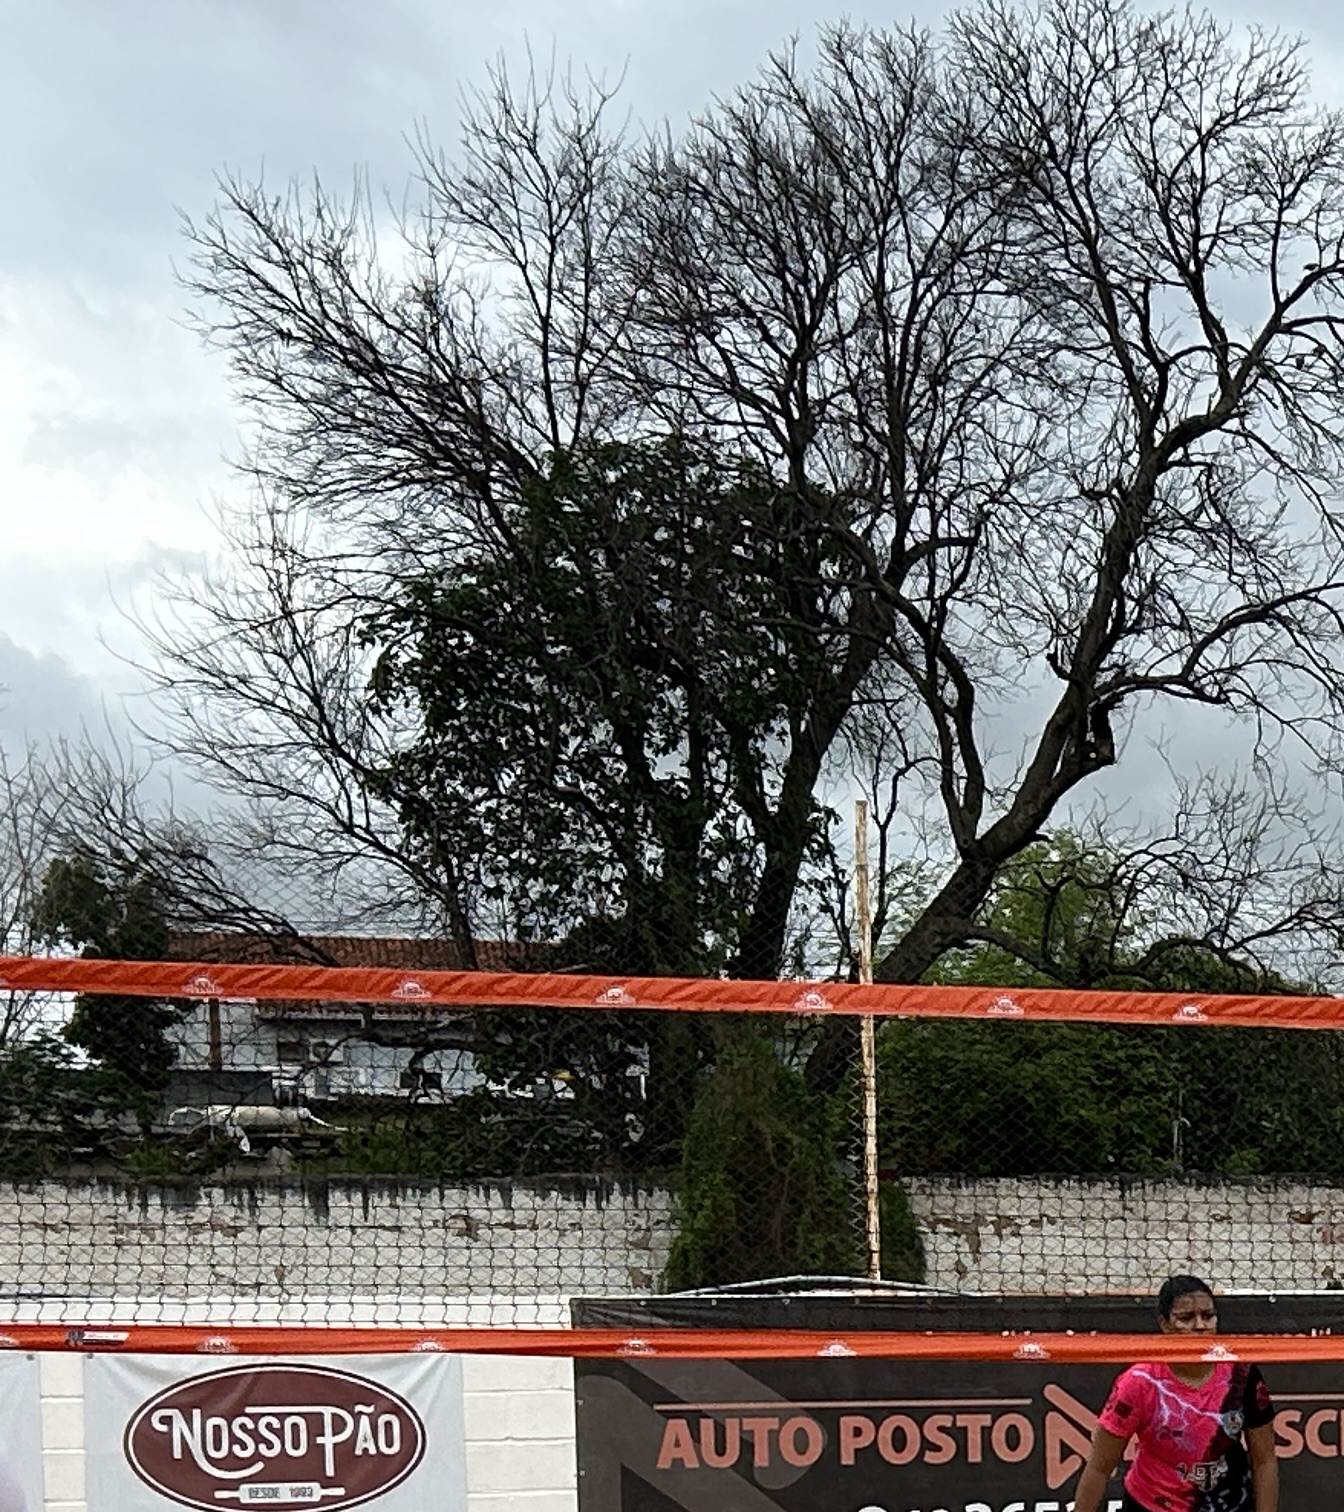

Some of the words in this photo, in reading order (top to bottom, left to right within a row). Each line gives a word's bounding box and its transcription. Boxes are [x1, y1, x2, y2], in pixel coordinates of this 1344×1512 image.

[150, 1407, 308, 1480] NOSSO
[656, 1415, 825, 1470] AUTO
[839, 1412, 1035, 1466] POSTO
